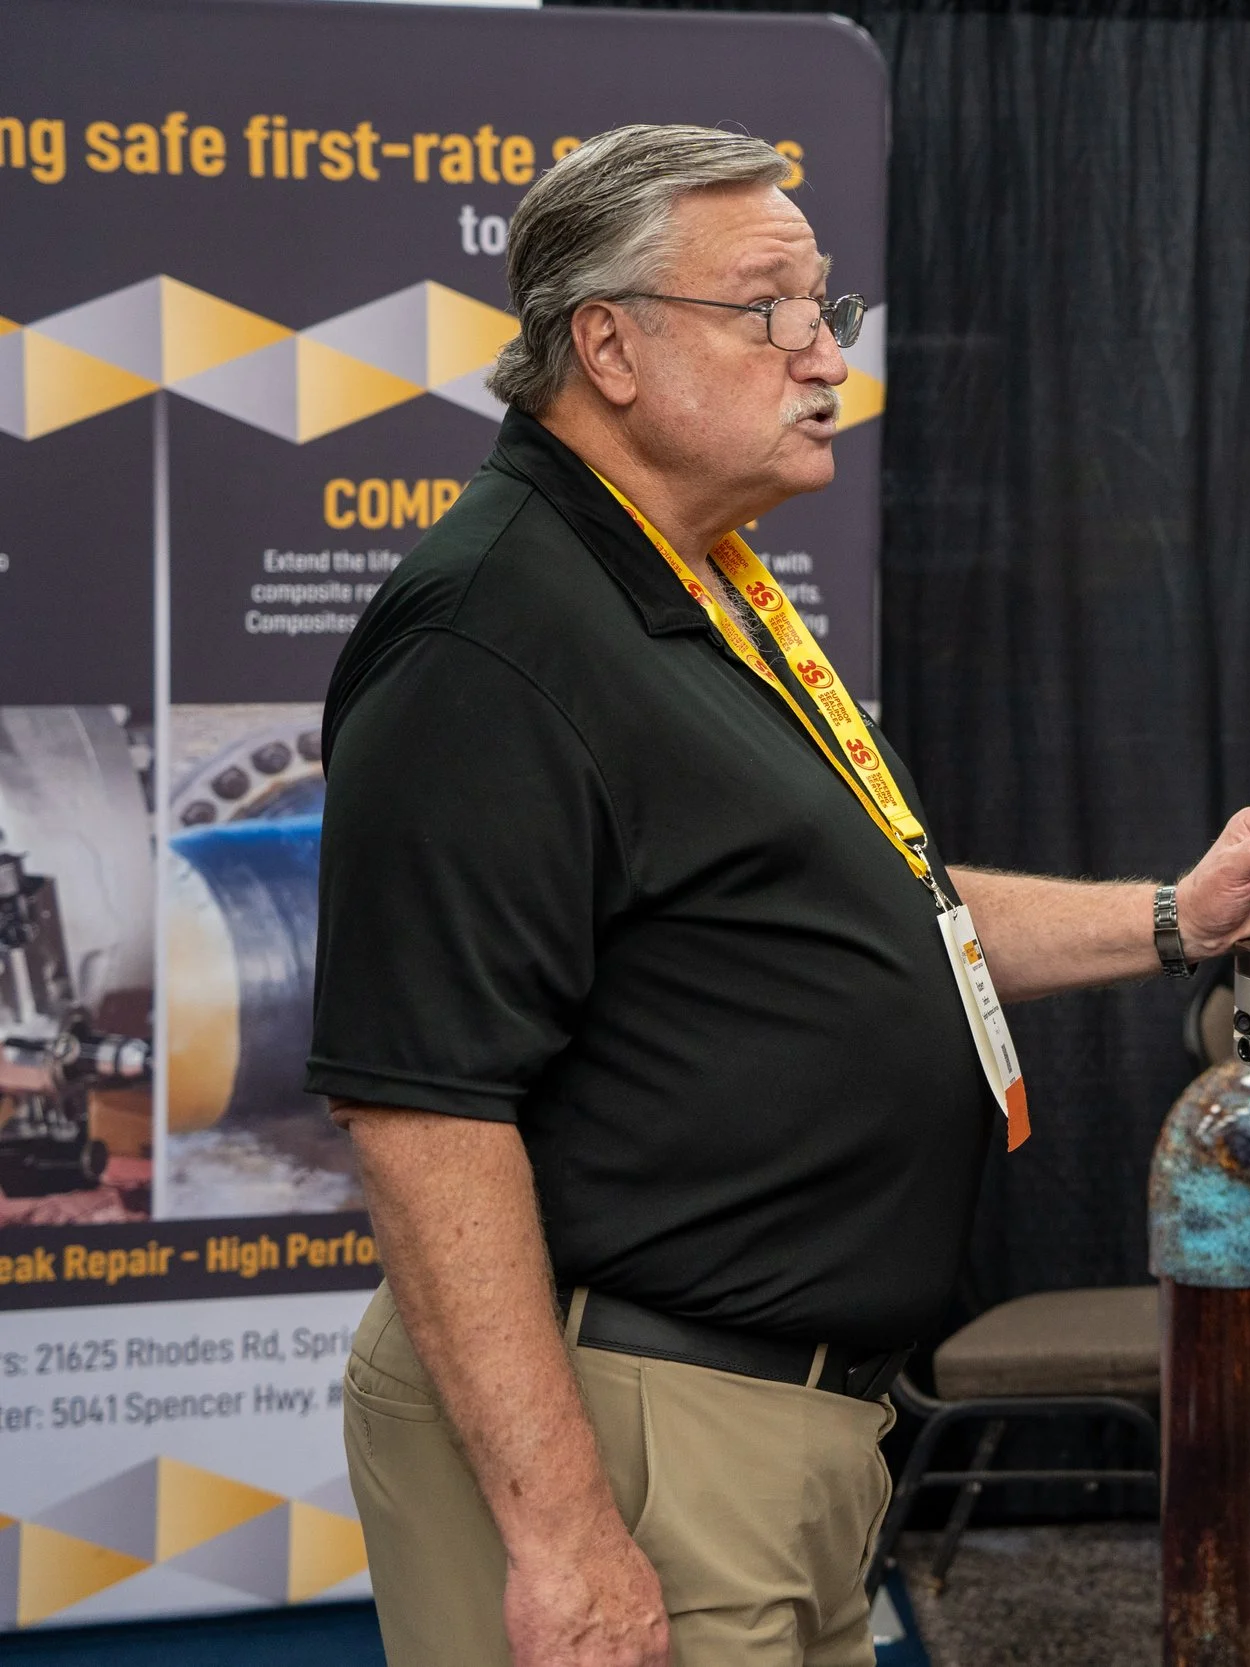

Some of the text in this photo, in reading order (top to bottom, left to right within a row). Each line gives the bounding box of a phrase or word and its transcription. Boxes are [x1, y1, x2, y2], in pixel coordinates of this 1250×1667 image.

[85, 111, 226, 177] safe
[243, 114, 535, 185] first-rate
[323, 477, 470, 530] COMP
[263, 549, 402, 573] Extend the life
[655, 540, 682, 574] SERVICES
[713, 548, 738, 576] SERVICES
[718, 543, 741, 569] SEALING
[723, 539, 749, 569] SUPERIOR
[772, 550, 813, 574] with
[250, 581, 352, 607] composite
[746, 581, 775, 607] 3S
[768, 617, 791, 652] SERVICES
[773, 614, 795, 645] SEALING
[779, 611, 803, 646] SUPERIOR
[797, 660, 825, 684] 3S
[817, 694, 841, 727] SERVICES
[822, 691, 844, 722] SEALING
[829, 689, 852, 724] SUPERIOR
[846, 739, 872, 765] 3S
[866, 776, 888, 809] SERVICES
[870, 774, 890, 805] SEALING
[876, 772, 898, 807] SUPERIOR
[63, 1240, 175, 1285] Repair
[206, 1235, 279, 1279] High
[0, 1349, 28, 1378] s:
[35, 1338, 119, 1375] 21625
[126, 1329, 234, 1370] Rhodes
[242, 1329, 286, 1364] Rd,
[0, 1404, 44, 1432] er:
[51, 1393, 119, 1429] 5041
[124, 1386, 246, 1427] Spencer
[253, 1382, 320, 1417] Hwy.
